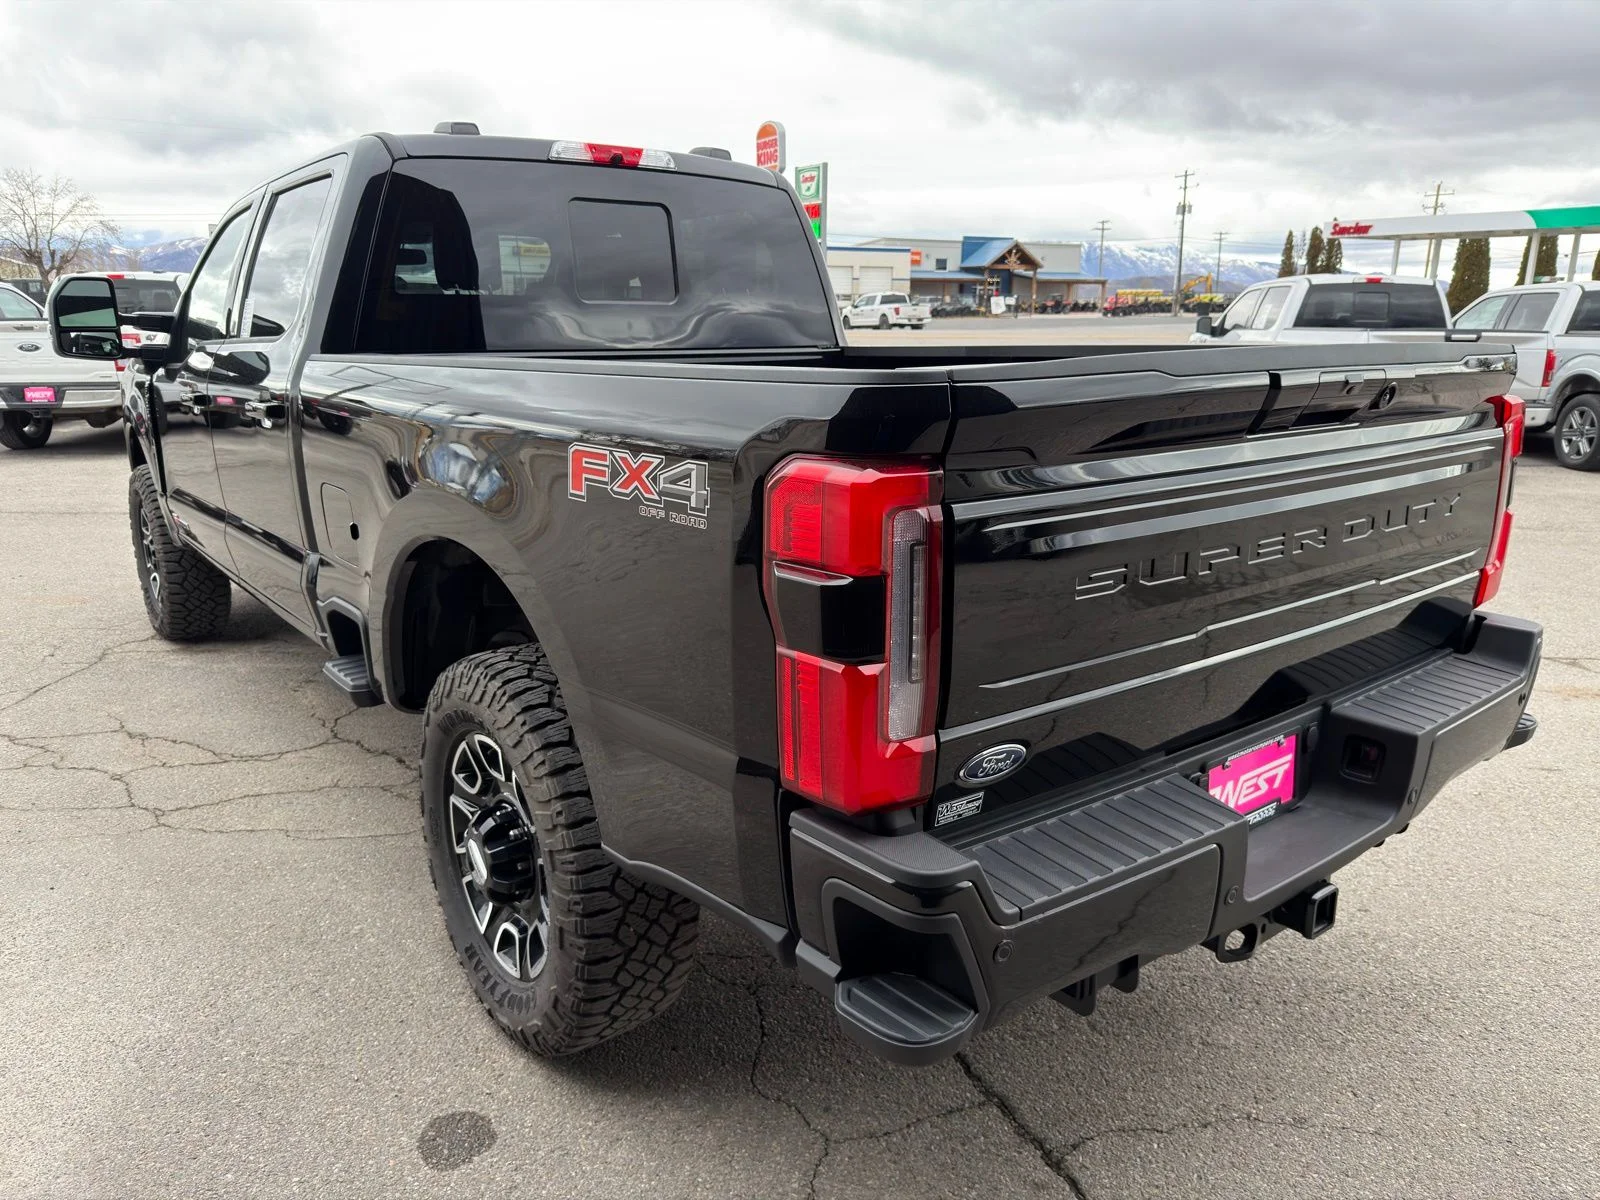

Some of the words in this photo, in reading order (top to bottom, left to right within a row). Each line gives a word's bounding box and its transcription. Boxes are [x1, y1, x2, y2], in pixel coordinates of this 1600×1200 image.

[757, 137, 778, 152] BURGER
[757, 149, 778, 166] KING
[1330, 222, 1373, 235] Sinclair
[568, 442, 710, 516] FX4
[639, 505, 665, 519] OFF
[669, 511, 707, 530] ROAD
[1074, 527, 1328, 601] SUPER
[1342, 492, 1462, 543] DUTY
[977, 752, 1015, 777] Ford
[1208, 753, 1293, 808] WEST
